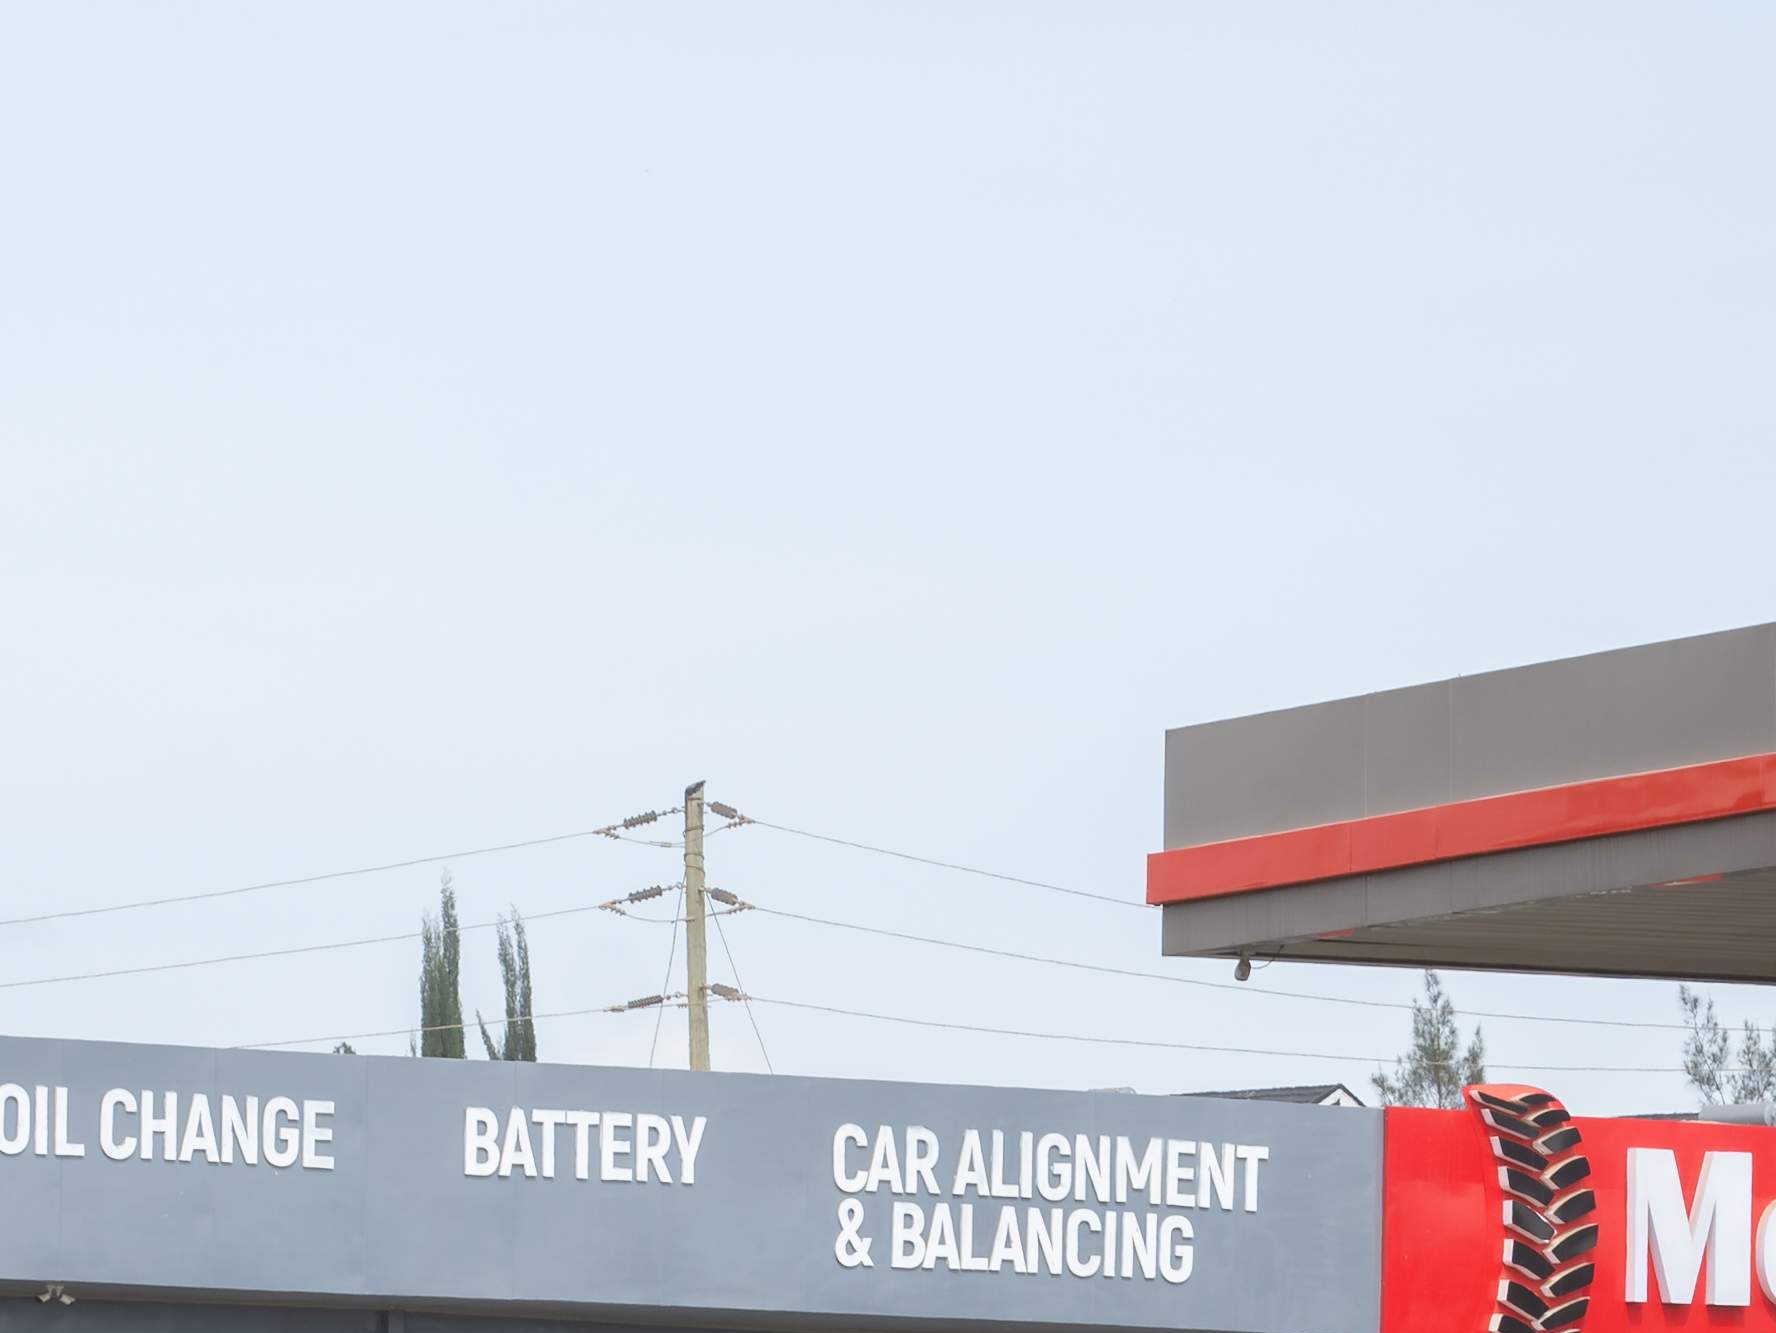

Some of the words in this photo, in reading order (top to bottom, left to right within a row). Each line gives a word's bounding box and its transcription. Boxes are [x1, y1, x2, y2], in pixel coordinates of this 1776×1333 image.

[99, 1088, 336, 1171] CHANGE
[463, 1106, 708, 1184] BATTERY
[832, 1123, 940, 1196] CAR
[953, 1128, 1270, 1212] ALIGNMENT
[834, 1198, 874, 1268] &
[890, 1202, 1194, 1284] BALANCING
